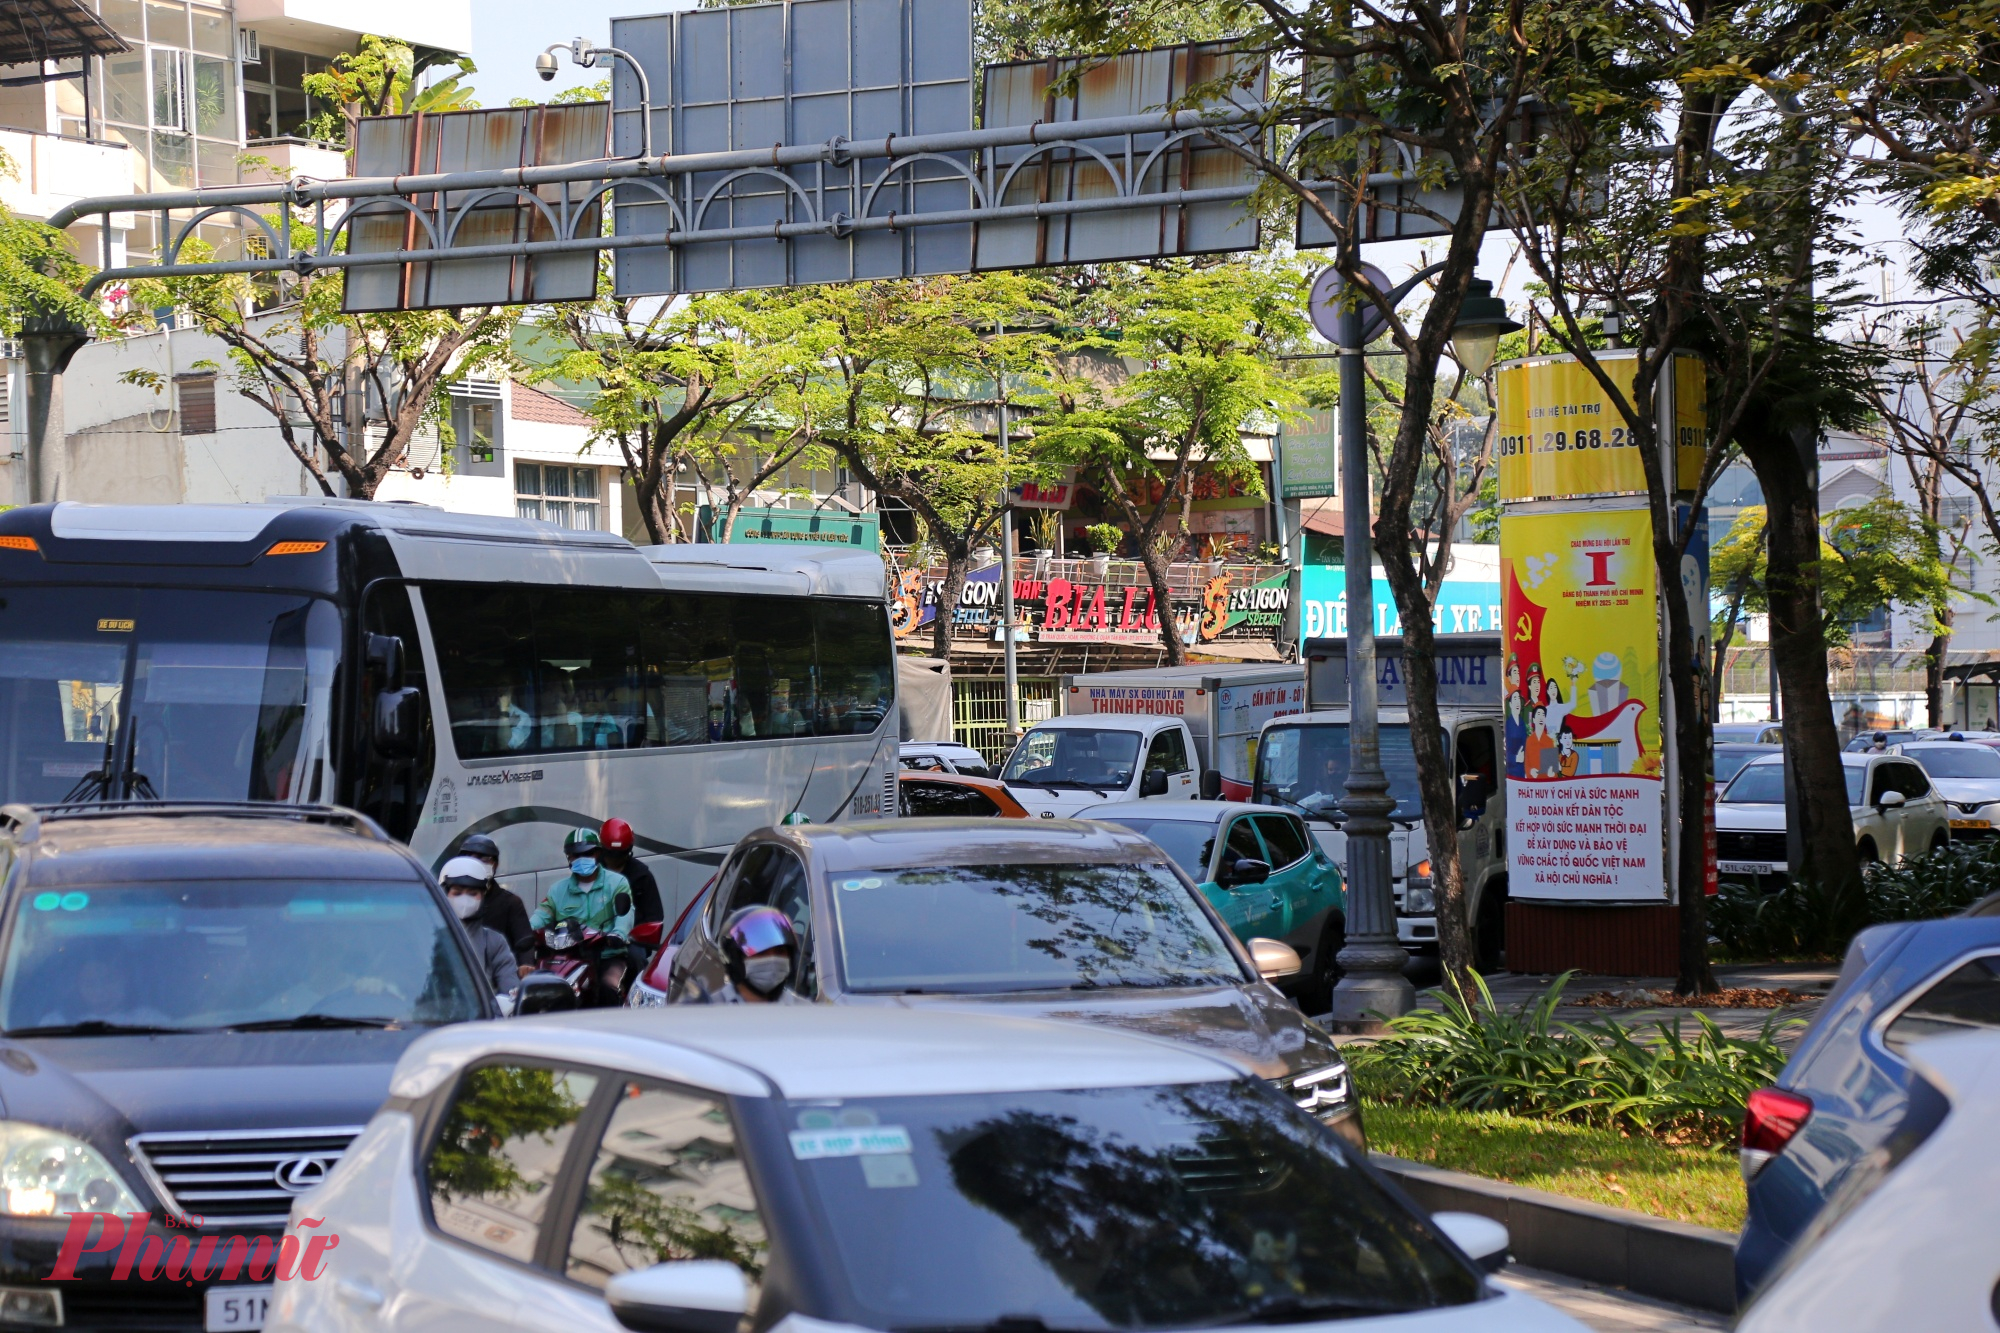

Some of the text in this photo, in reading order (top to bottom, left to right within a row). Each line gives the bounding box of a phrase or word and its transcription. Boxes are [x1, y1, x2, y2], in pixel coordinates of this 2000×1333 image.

[1585, 552, 1616, 586] I
[1238, 588, 1289, 609] SAIGON
[1247, 612, 1282, 626] SPECIAL
[1451, 604, 1481, 633] XE
[1518, 787, 1640, 802] PHÁT HUY Ý CHÍ VÀ SỨC MẠNH
[1528, 802, 1624, 819] ĐẠI ĐOÀN KẾT DÂN TỘC
[1516, 819, 1646, 836] KẾT HỢP VỚI SỨC MẠNH THỜI ĐẠI
[1528, 834, 1628, 853] ĐỂ XÂY DỰNG VÀ BẢO VỆ
[1518, 852, 1646, 870] VỮNG CHẮC TỔ QUỐC VIỆT NAM
[1535, 870, 1545, 882] XÃ
[1546, 871, 1560, 886] HỘI
[1562, 871, 1580, 884] CHỦ
[1582, 872, 1612, 884] NGHĨA
